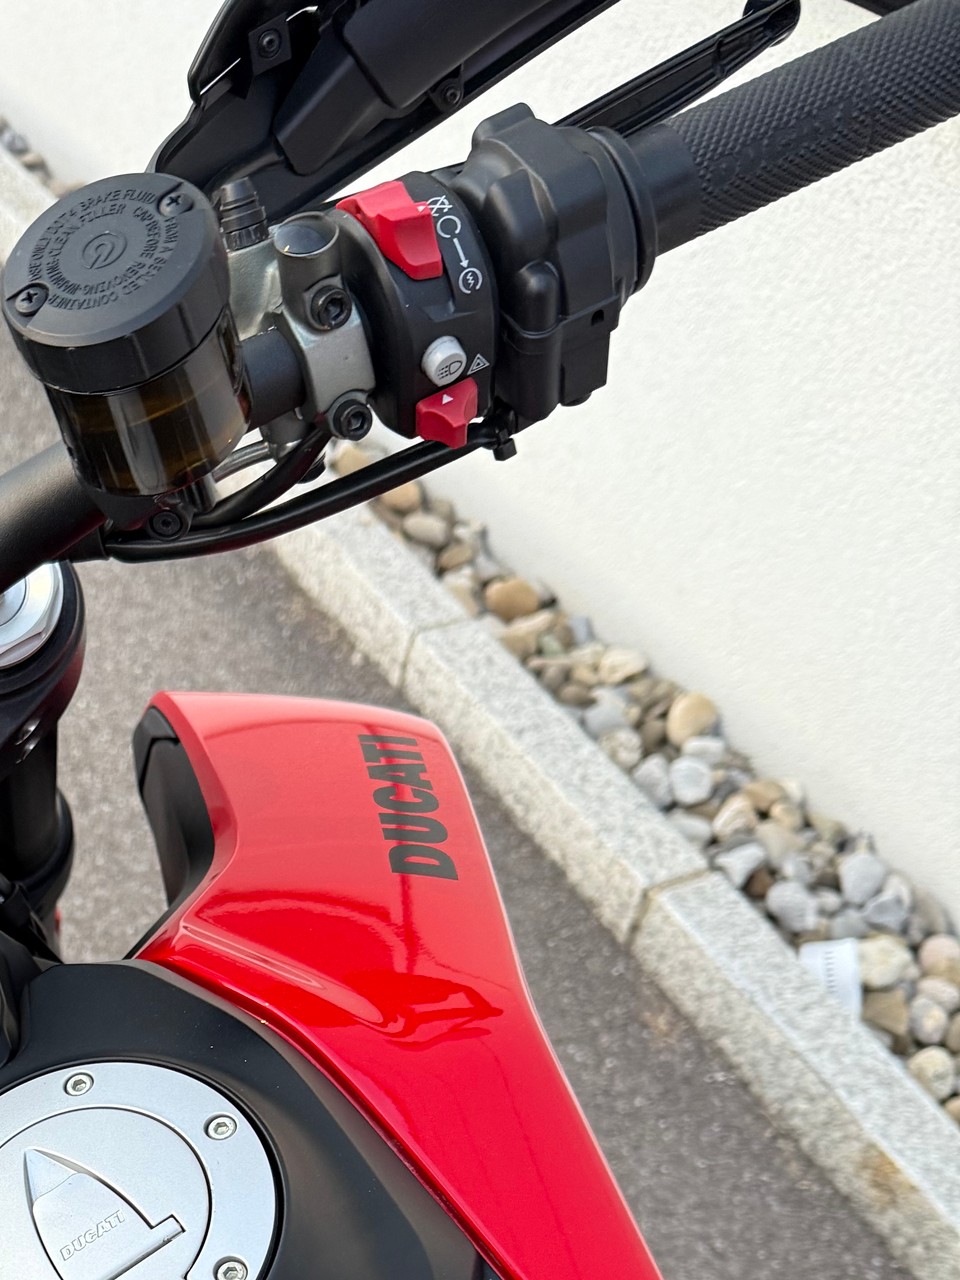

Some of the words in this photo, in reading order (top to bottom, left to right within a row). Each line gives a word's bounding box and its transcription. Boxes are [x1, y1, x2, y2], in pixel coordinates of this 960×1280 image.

[79, 203, 127, 227] FILLER
[80, 189, 121, 212] BRAKE
[123, 189, 156, 205] FLUID
[358, 734, 459, 881] DUCATI
[59, 1209, 126, 1262] DUCATI
